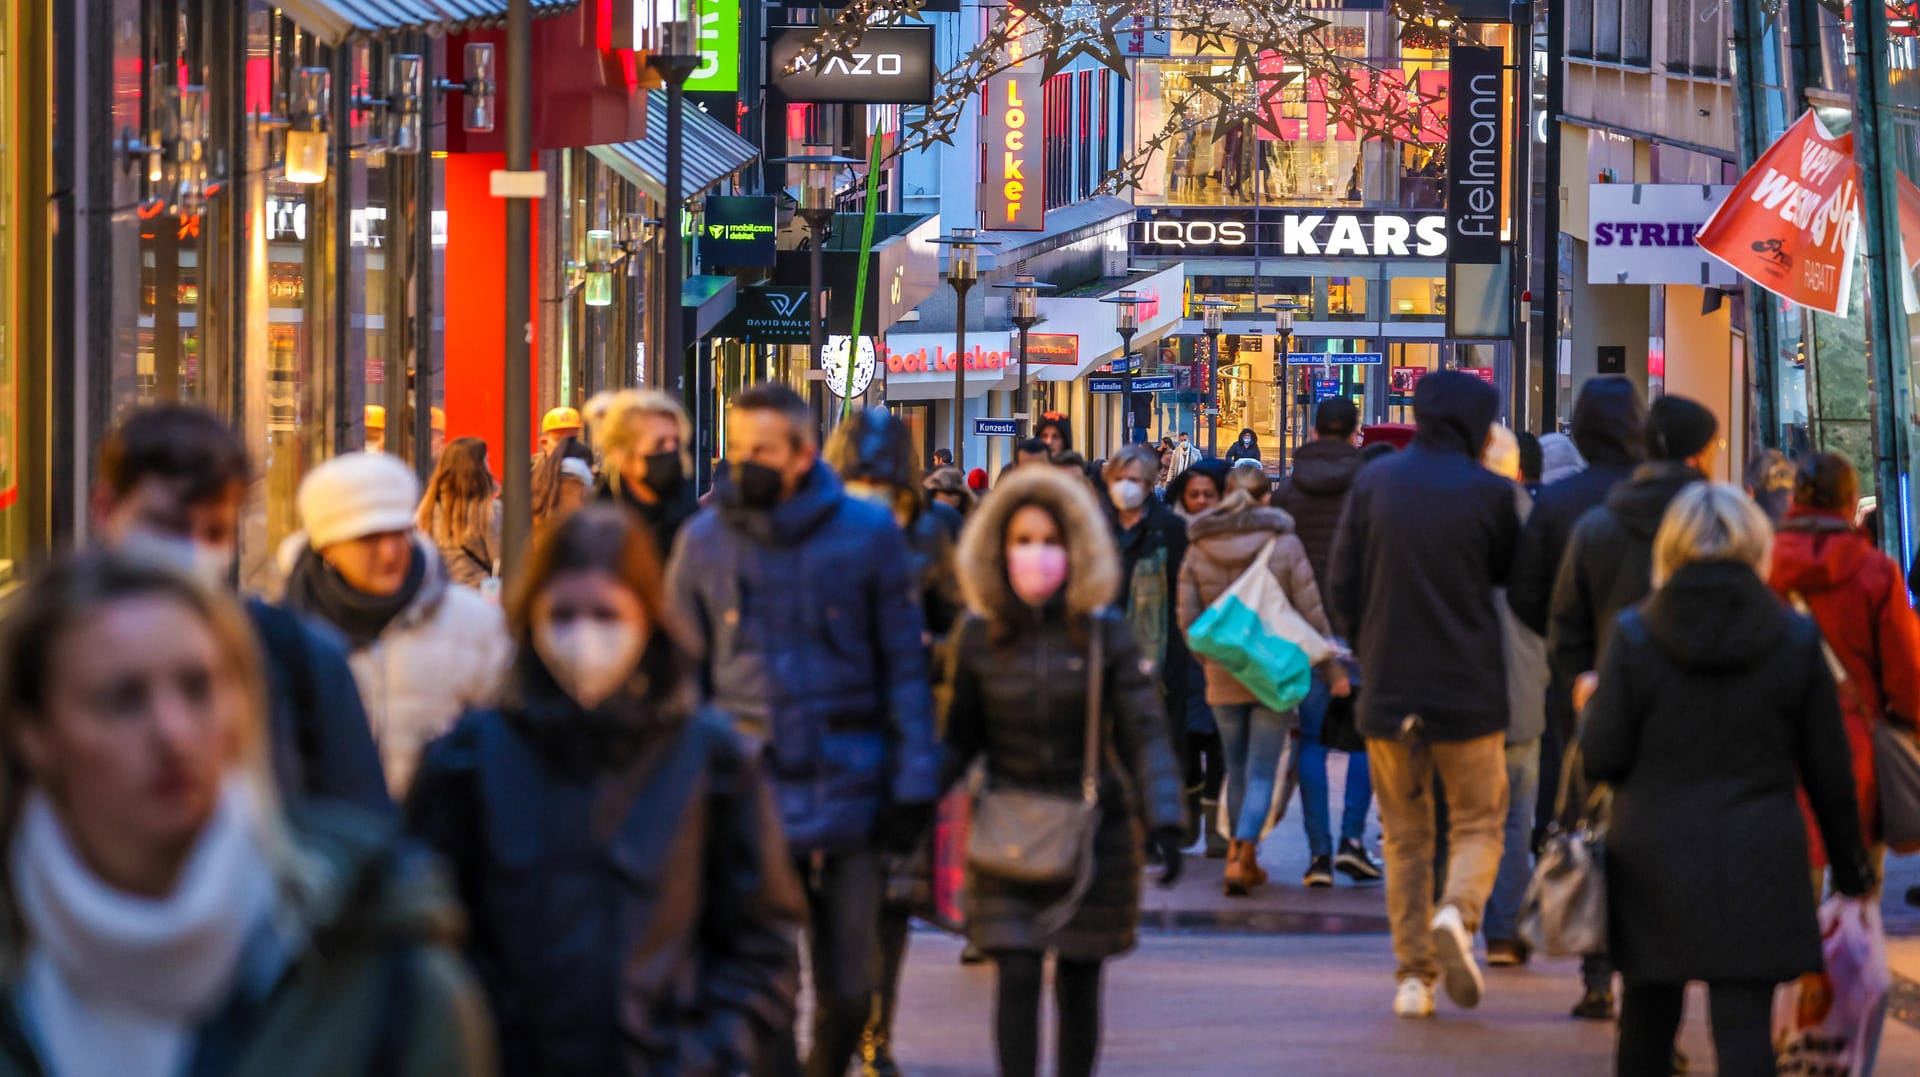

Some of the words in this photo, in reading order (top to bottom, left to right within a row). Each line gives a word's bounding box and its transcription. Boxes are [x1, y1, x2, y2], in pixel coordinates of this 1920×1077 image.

[1004, 79, 1026, 223] Locker
[1457, 74, 1497, 236] fielmann
[1145, 221, 1246, 248] IQOS
[1284, 215, 1447, 257] KARS
[747, 319, 779, 327] DAVID
[781, 320, 825, 328] WALK
[935, 344, 1011, 371] Locker
[979, 422, 1016, 433] Kunzestr.
